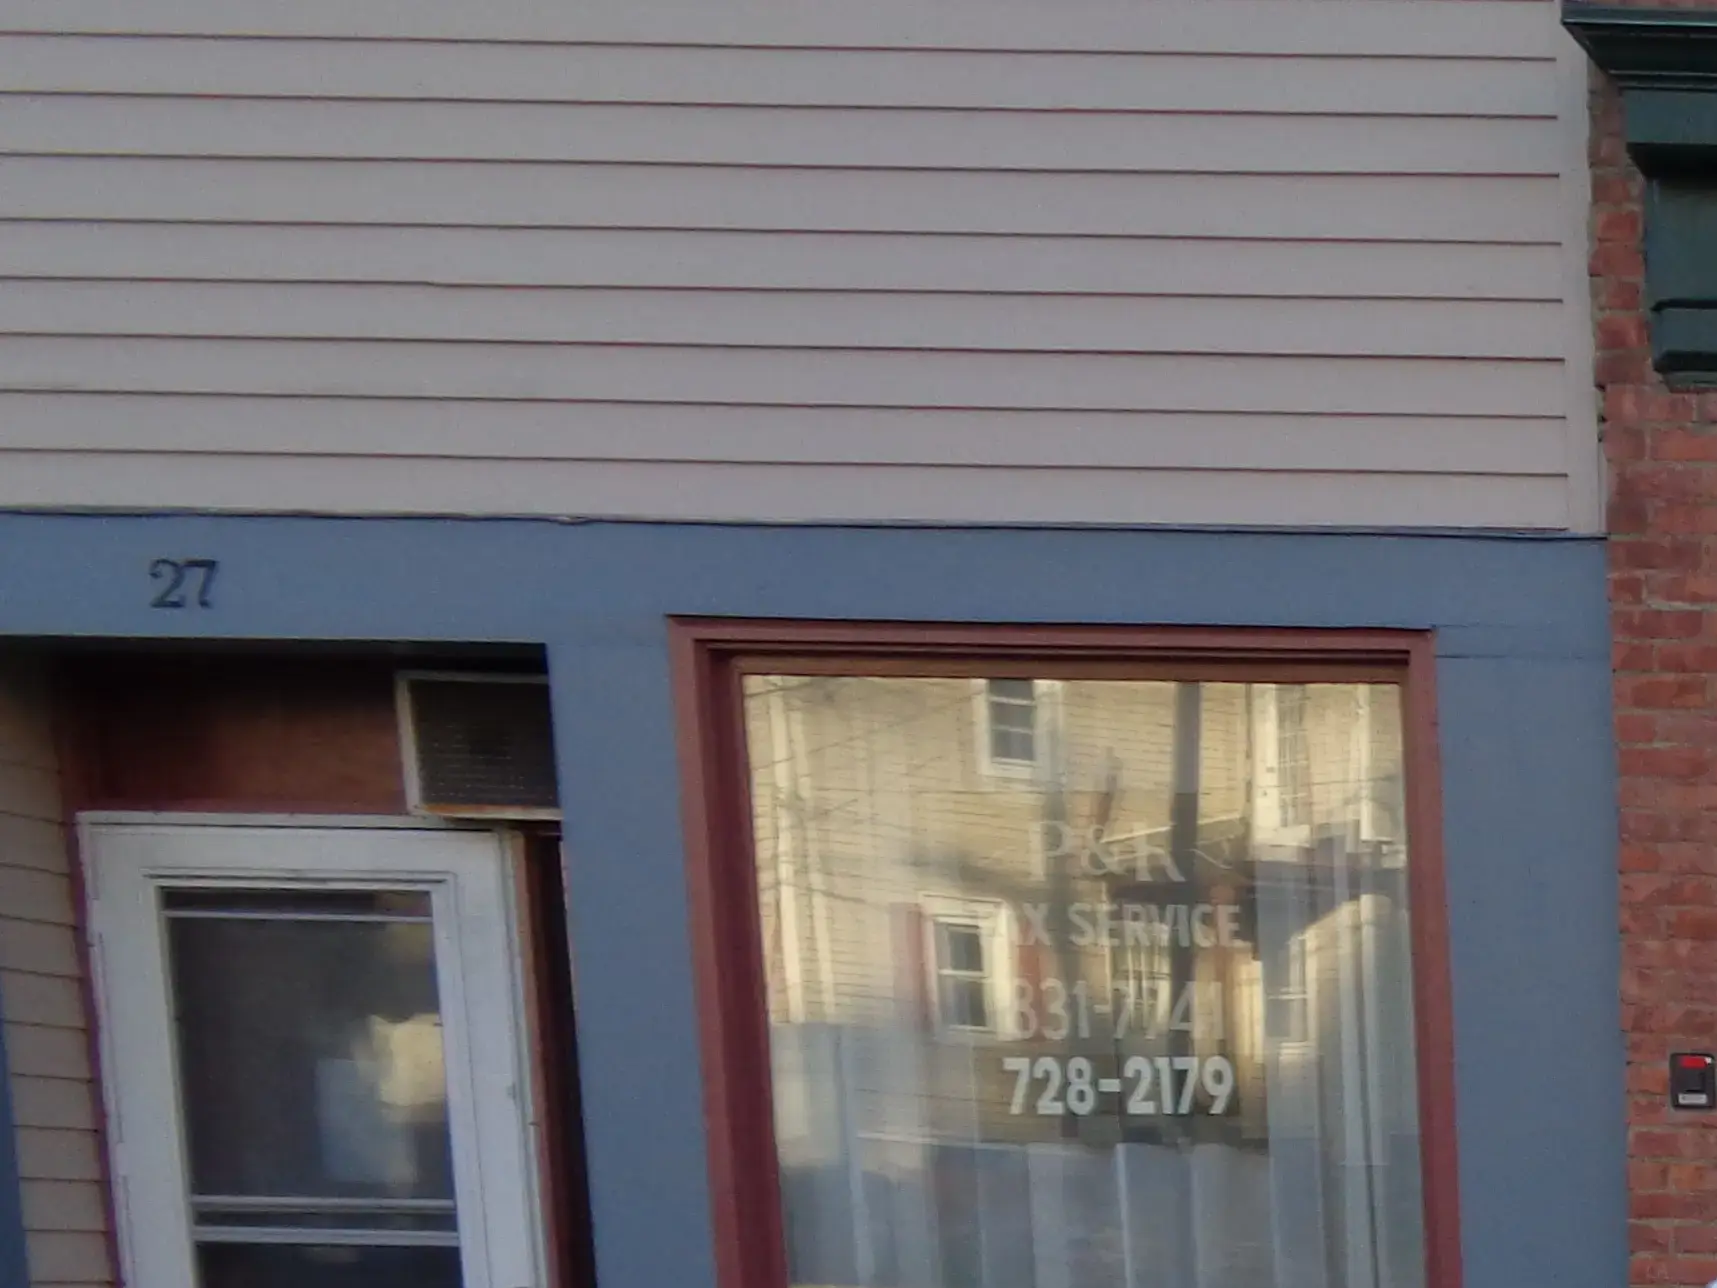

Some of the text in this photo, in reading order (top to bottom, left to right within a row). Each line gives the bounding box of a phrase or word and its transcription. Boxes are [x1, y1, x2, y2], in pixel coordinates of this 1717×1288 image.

[149, 558, 219, 610] 27
[1068, 902, 1243, 948] SERVICE
[1003, 1055, 1235, 1116] 728-2179
